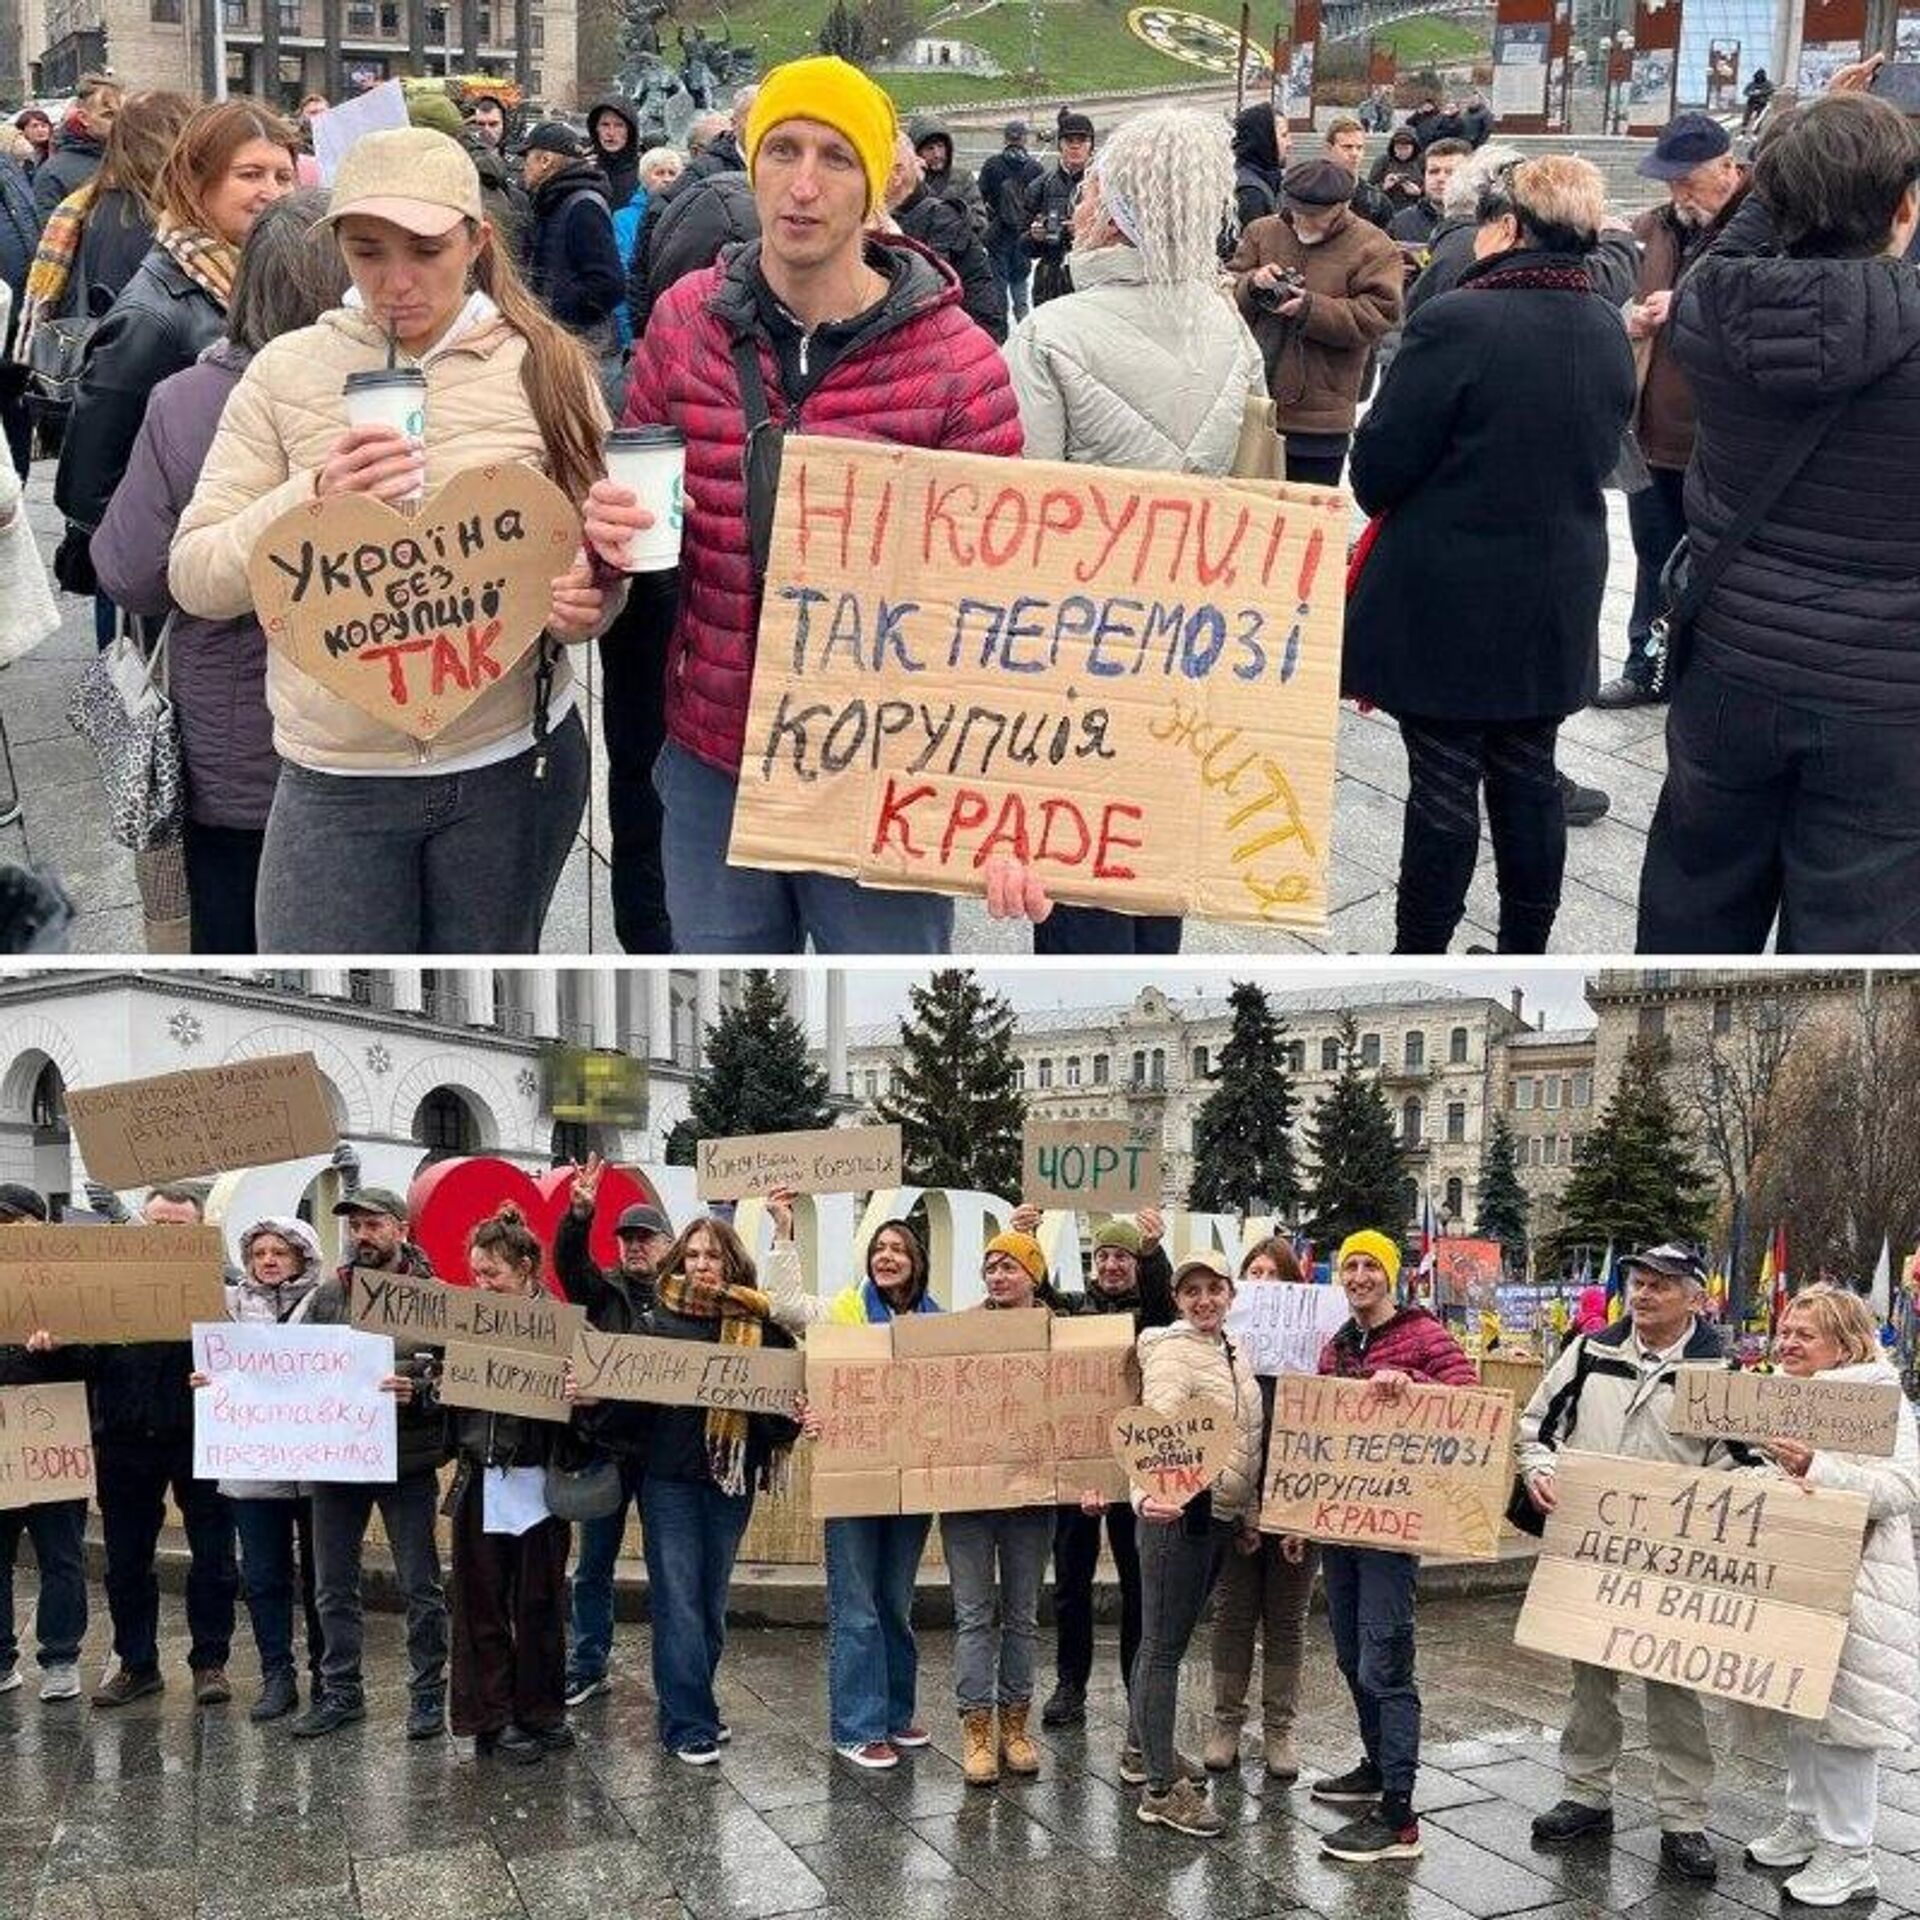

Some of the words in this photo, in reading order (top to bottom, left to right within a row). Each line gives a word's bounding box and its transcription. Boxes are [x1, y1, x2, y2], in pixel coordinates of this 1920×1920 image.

[269, 509, 525, 601] Україна
[799, 455, 900, 568] НІ
[923, 478, 1344, 600] КОРУПЦІЇ
[359, 619, 502, 704] ТАК
[778, 586, 926, 674] ТАК
[948, 596, 1312, 683] ПЕРЕМОЗІ
[1038, 1145, 1150, 1192] ЧОРТ
[1117, 1418, 1215, 1449] Україна
[1276, 1430, 1333, 1463] ТАК
[1344, 1432, 1496, 1468] ПЕРЕМОЗІ
[1149, 1466, 1205, 1495] ТАК
[1597, 1489, 1649, 1533] СТ.
[1669, 1479, 1769, 1549] 111
[1596, 1574, 1644, 1610] НА
[1656, 1585, 1759, 1633] ВАШІ
